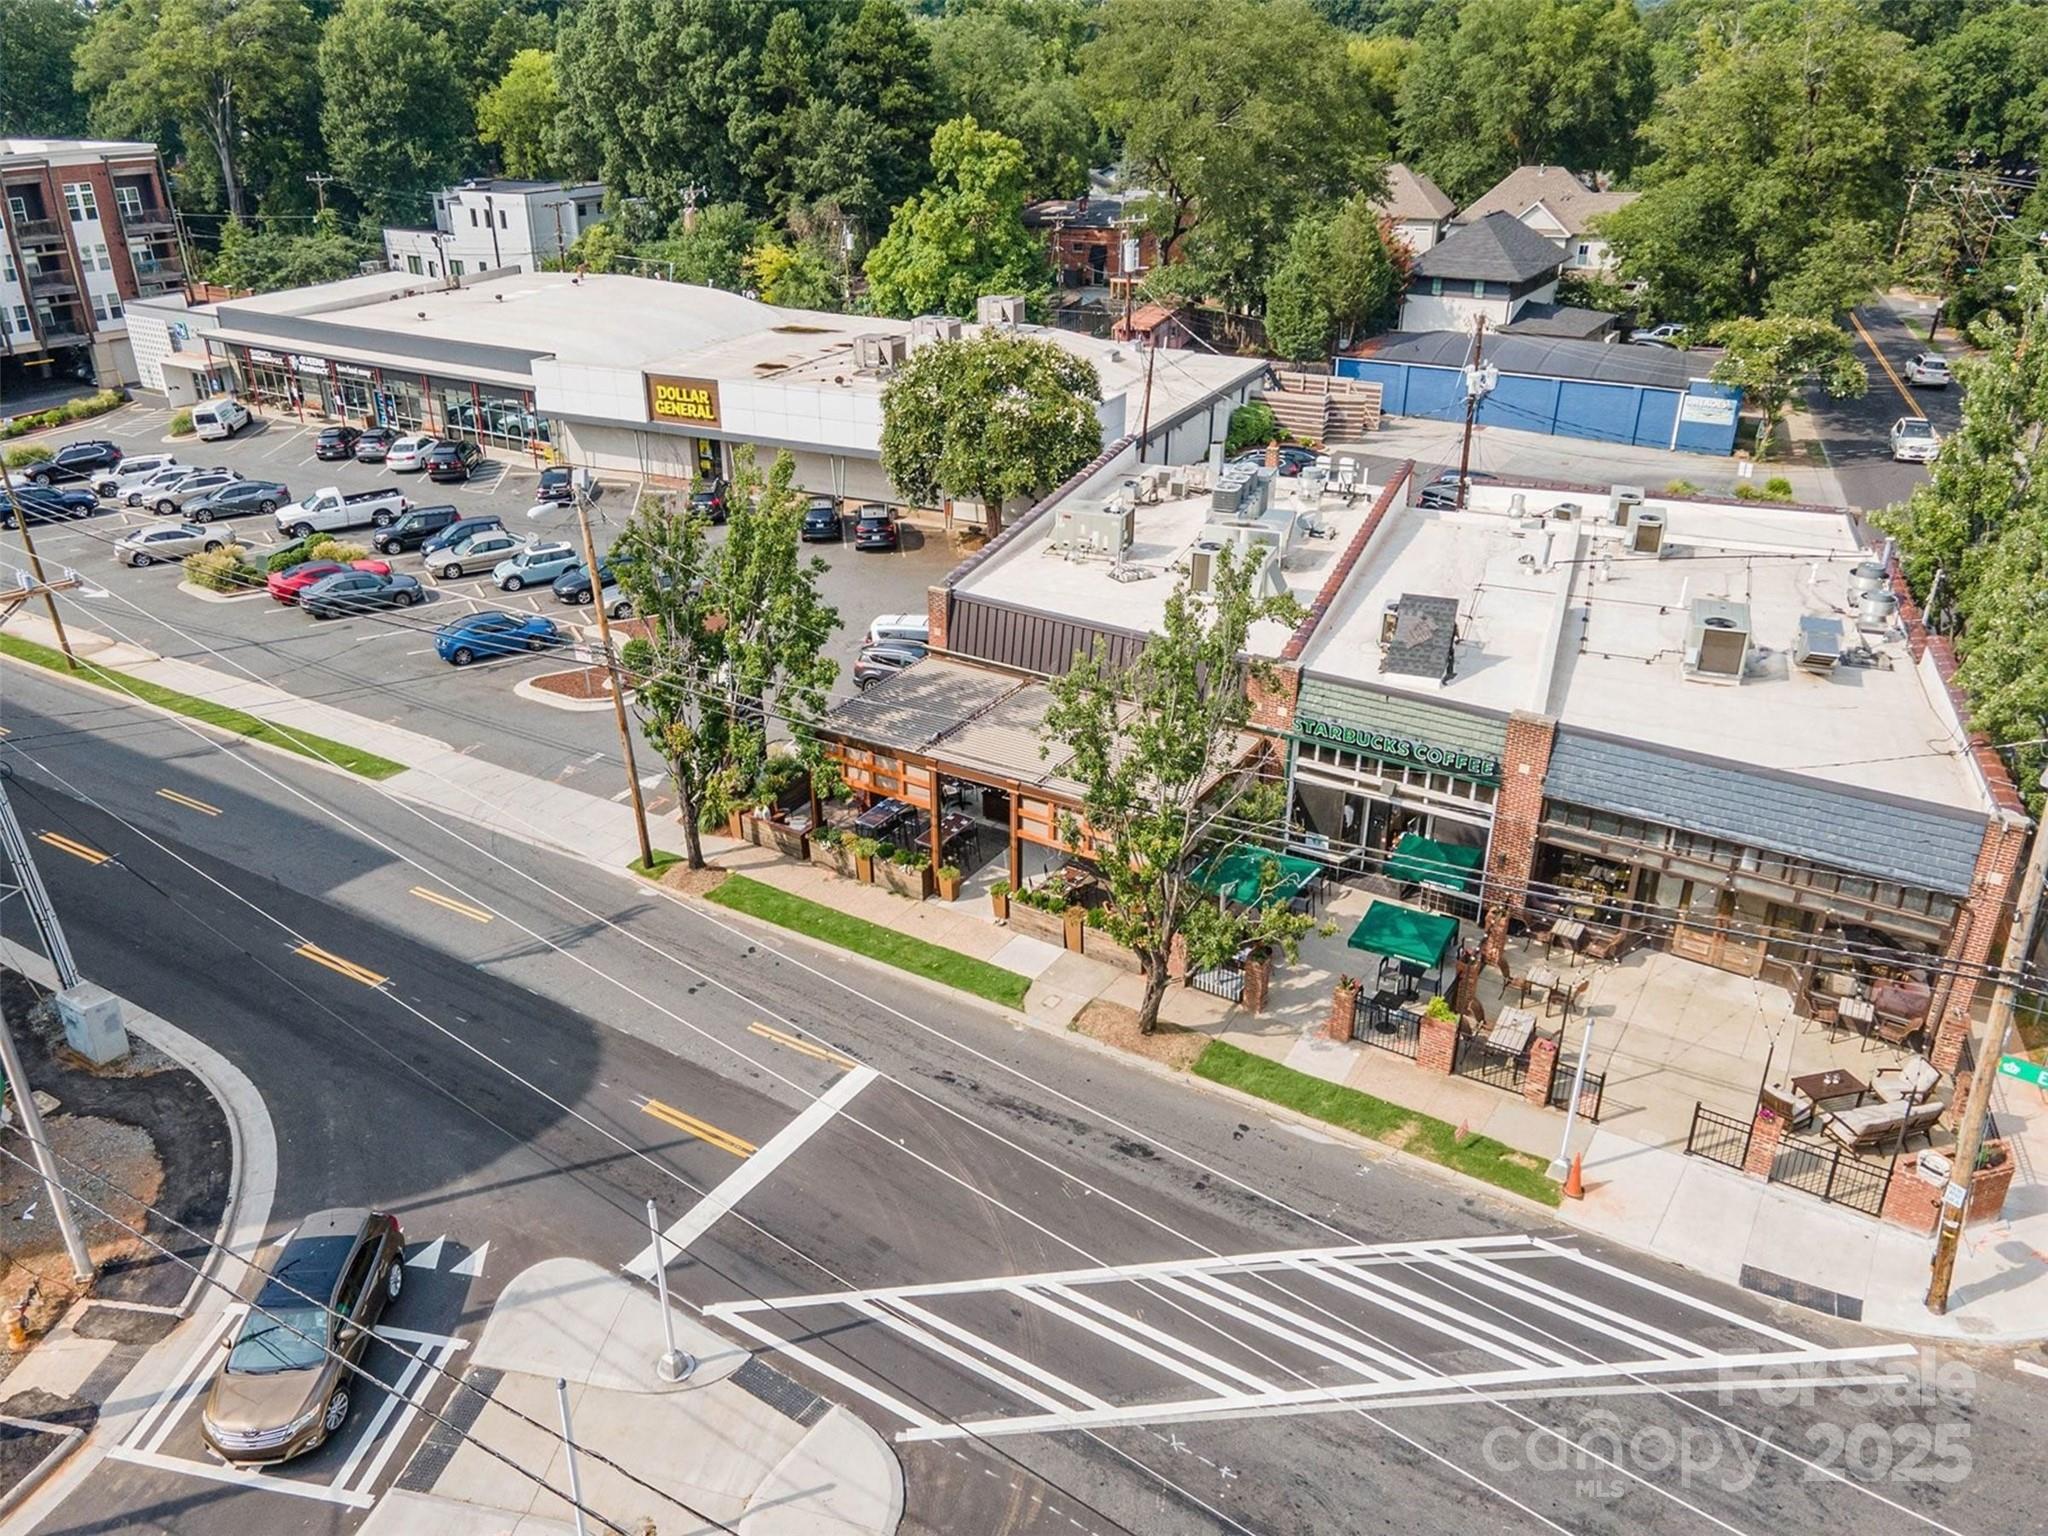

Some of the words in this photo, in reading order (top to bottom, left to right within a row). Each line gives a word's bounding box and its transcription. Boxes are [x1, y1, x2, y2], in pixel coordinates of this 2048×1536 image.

[656, 385, 710, 404] DOLLAR
[655, 400, 714, 419] GENERAL
[1293, 717, 1410, 757] STARBUCKS
[1413, 744, 1495, 777] COFFEE
